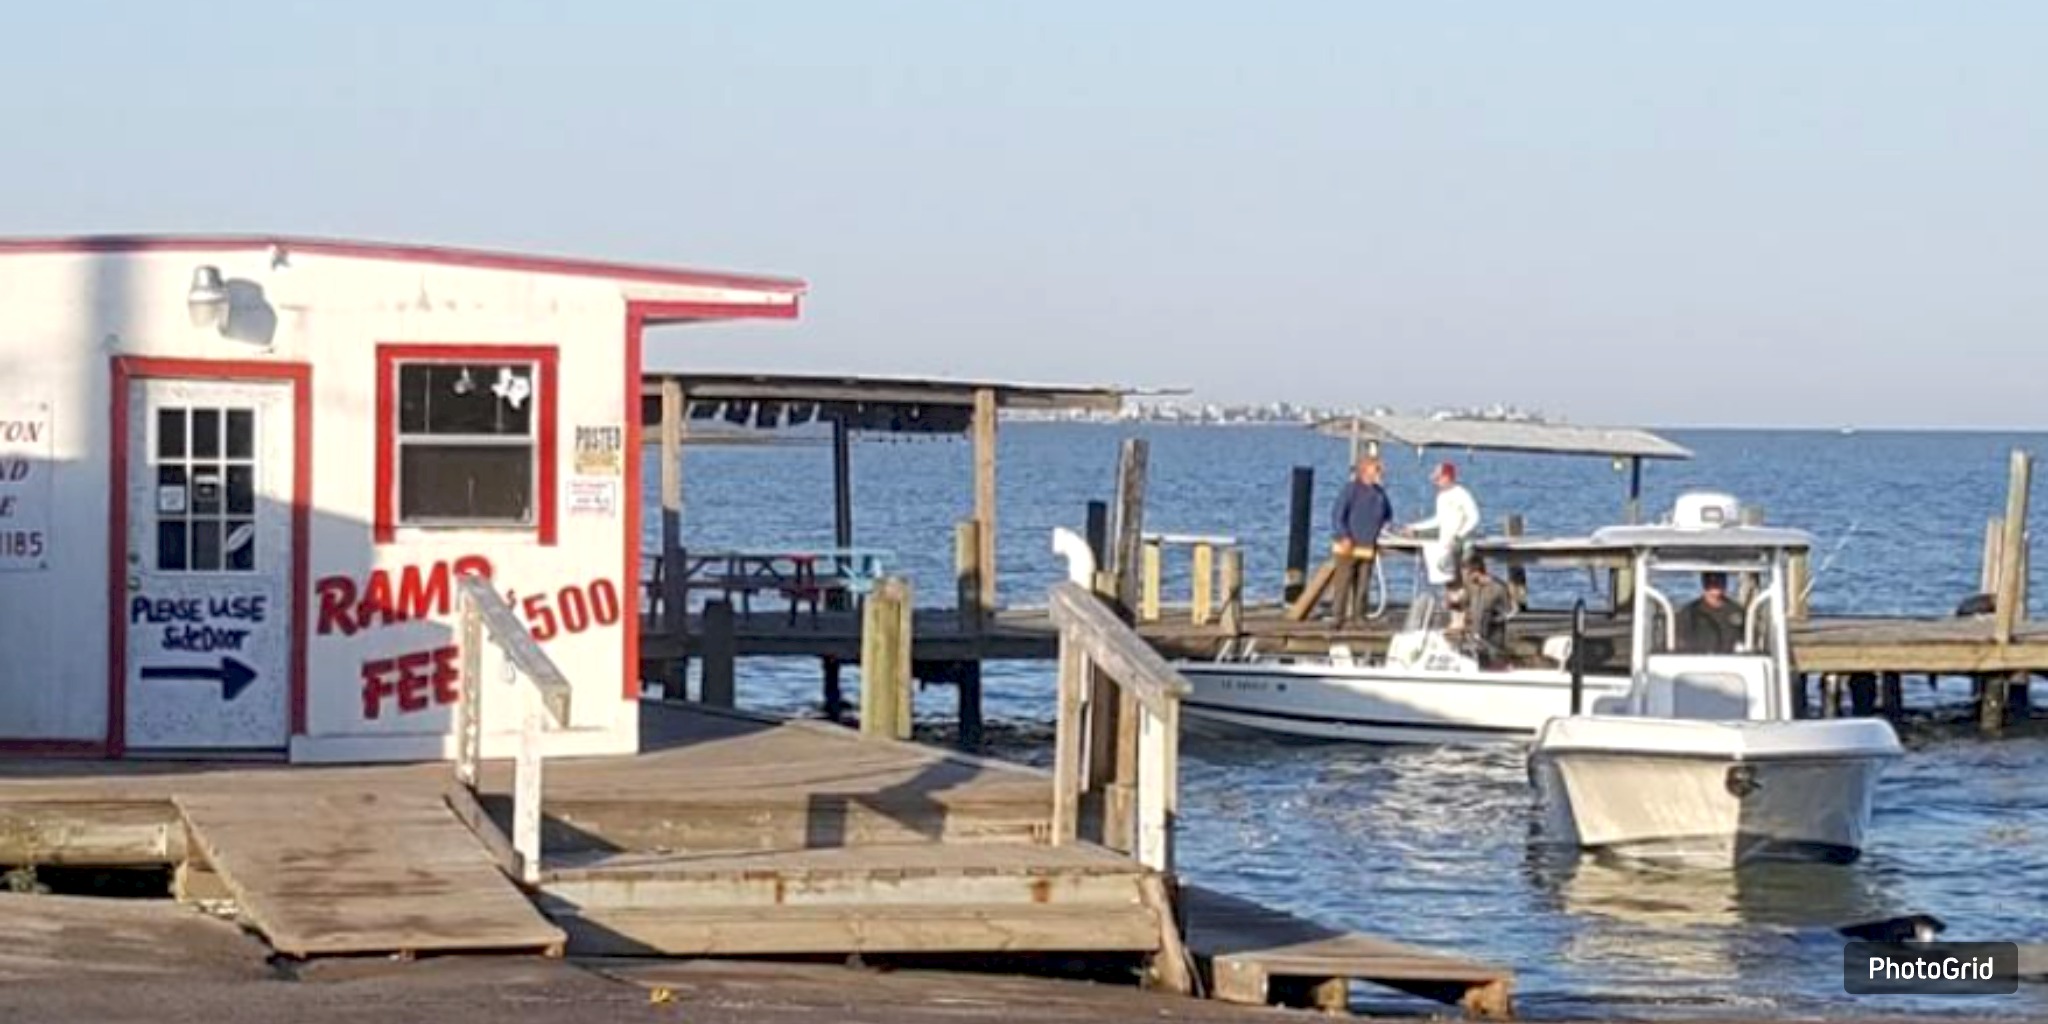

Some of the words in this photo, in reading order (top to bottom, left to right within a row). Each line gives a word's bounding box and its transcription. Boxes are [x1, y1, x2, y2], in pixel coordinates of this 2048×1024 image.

[131, 595, 204, 624] PLEASE
[208, 595, 267, 622] USE
[360, 645, 459, 720] FEE
